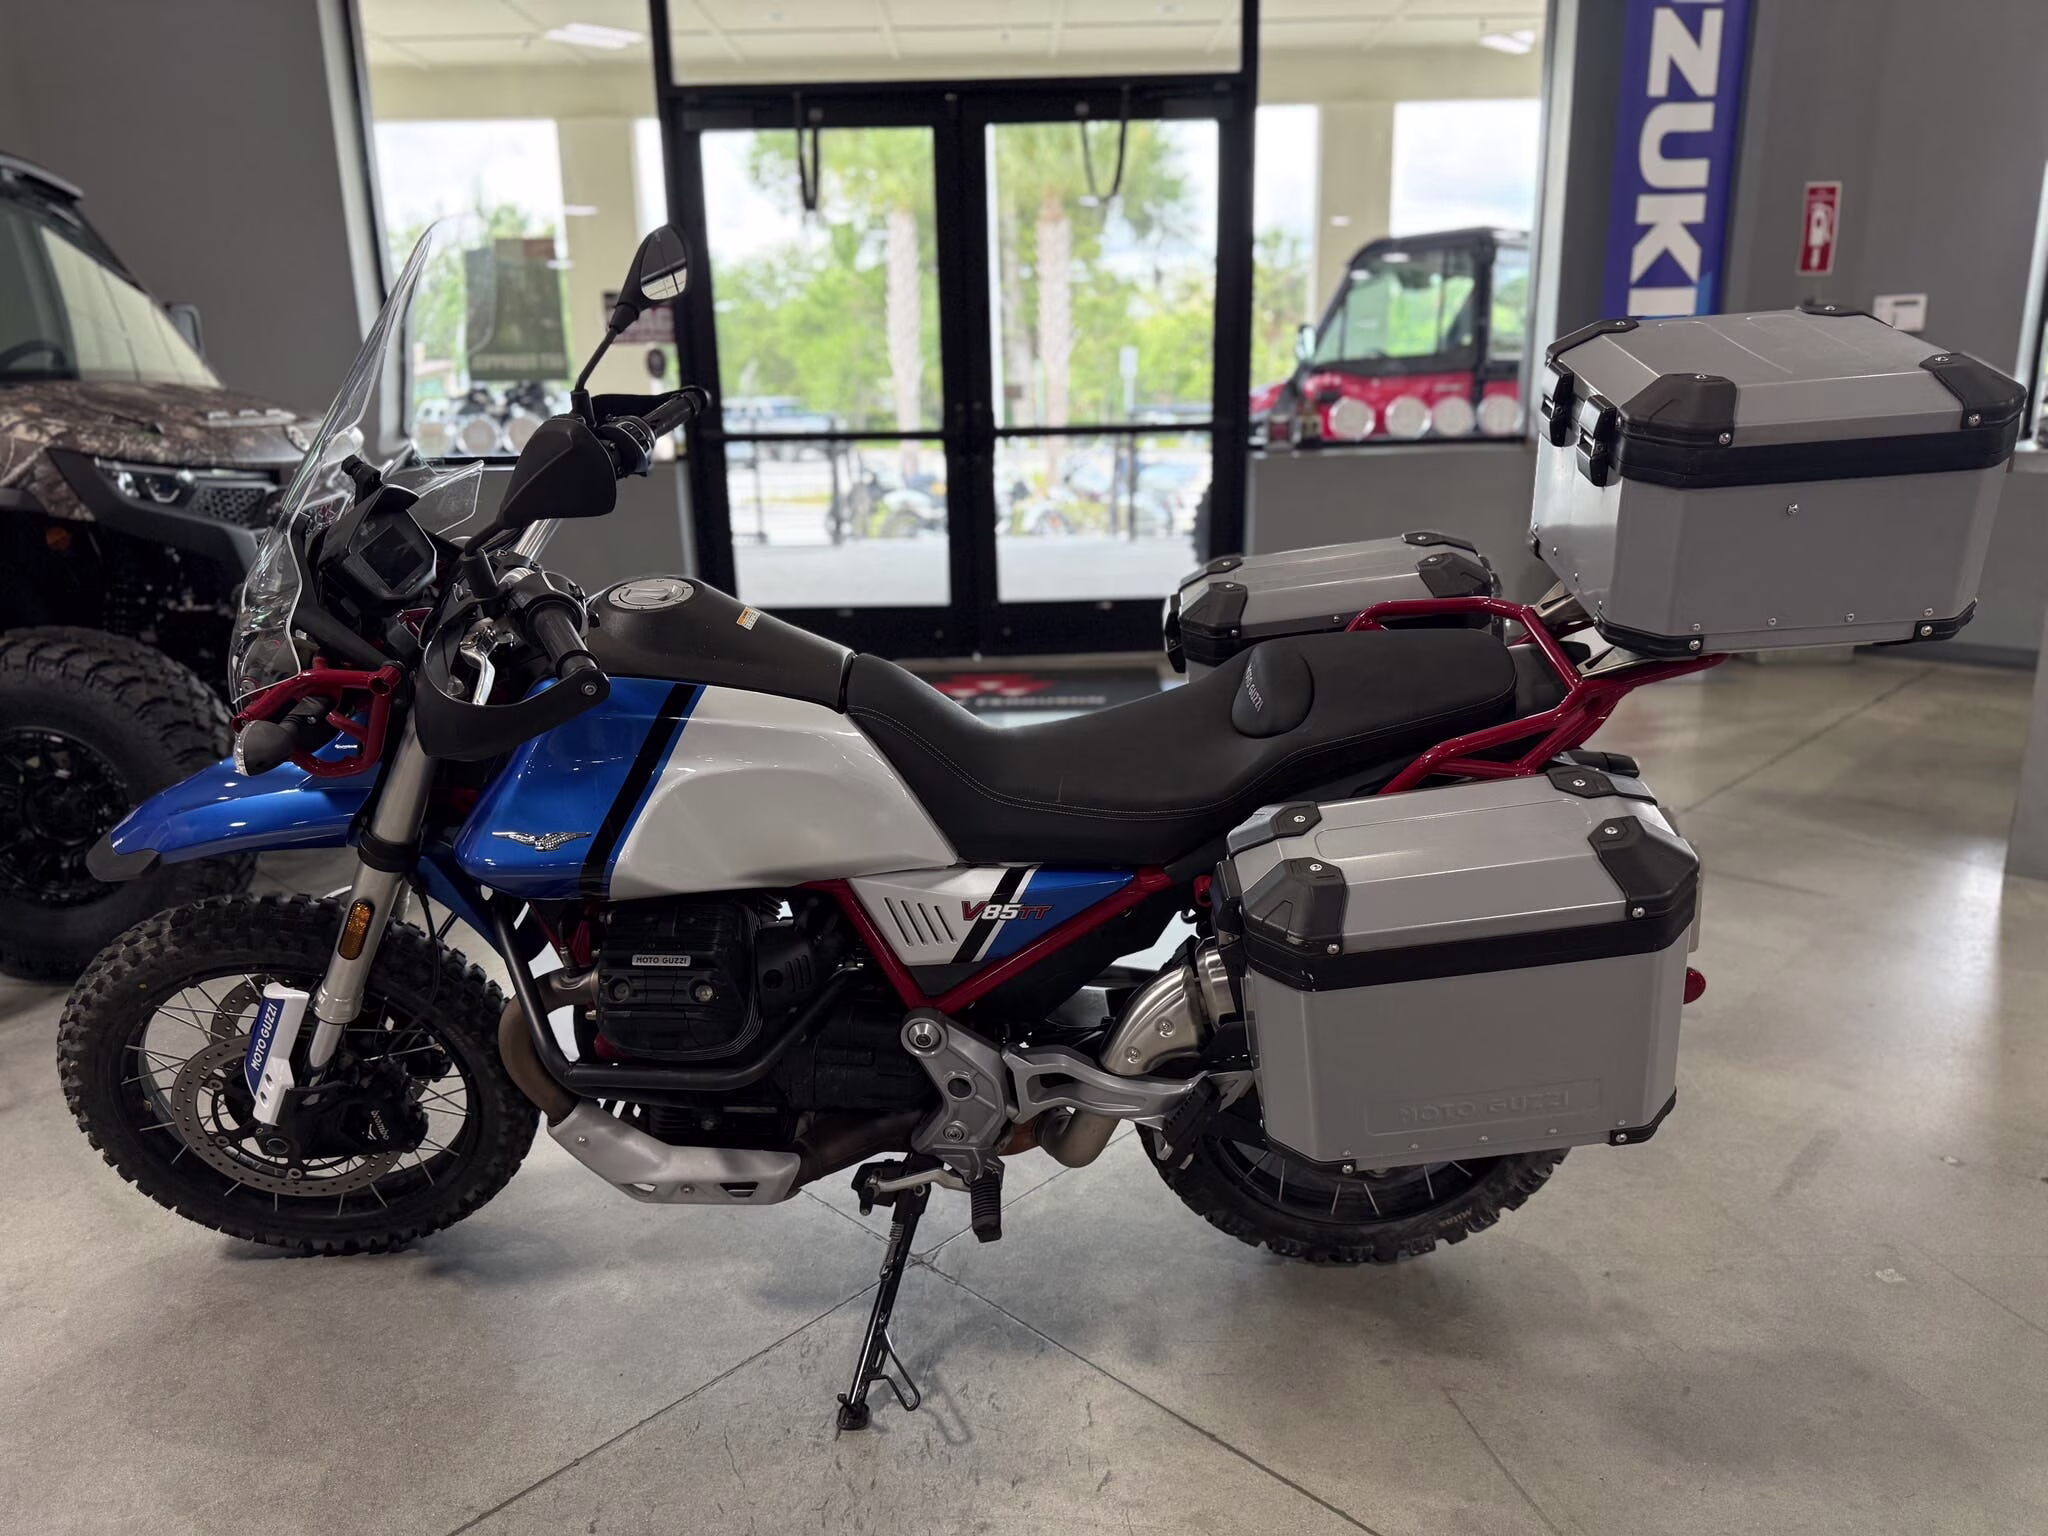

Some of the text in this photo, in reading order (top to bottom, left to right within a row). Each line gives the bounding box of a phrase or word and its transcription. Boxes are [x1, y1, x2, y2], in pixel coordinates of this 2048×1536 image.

[1627, 0, 1724, 317] ZUKI
[1248, 683, 1264, 712] GUZZI
[961, 900, 1053, 921] V85TT
[636, 956, 687, 965] MOTO GUZZI
[250, 1002, 278, 1072] MOTO GUZZI
[1398, 1091, 1569, 1123] MOTO GUZZI
[370, 1110, 390, 1140] brembo
